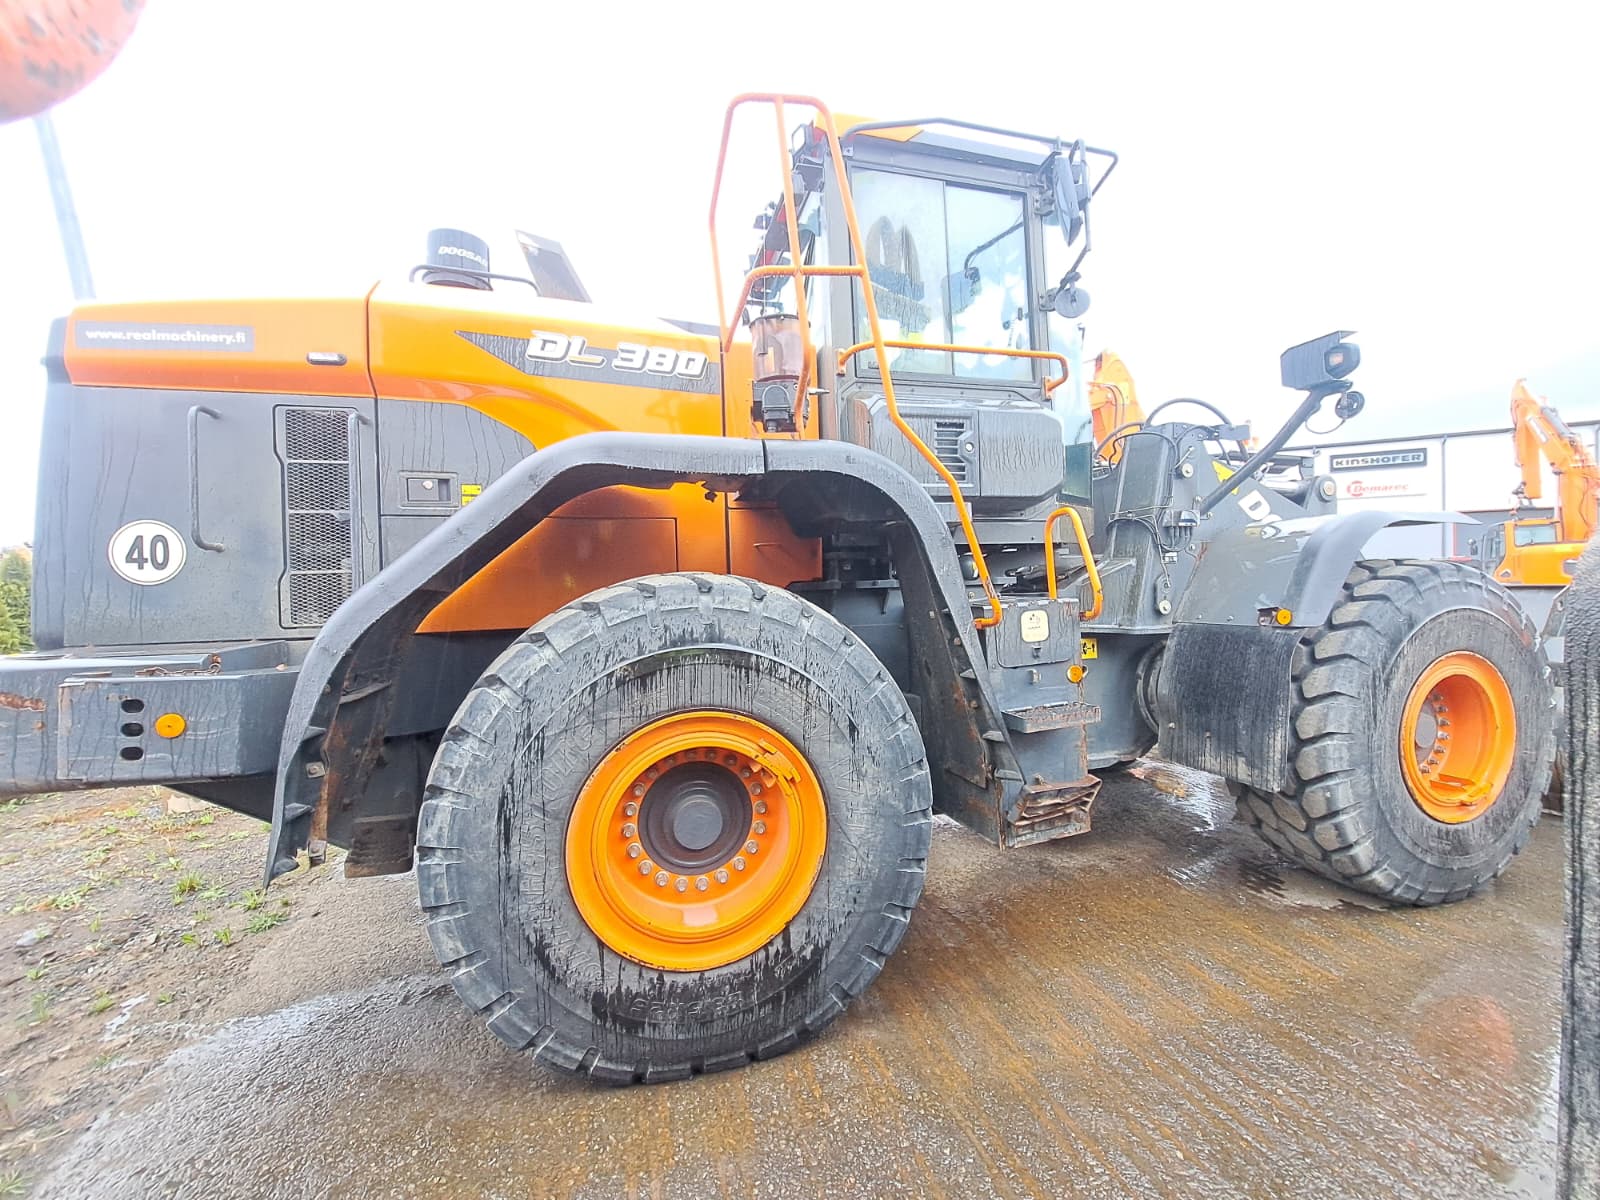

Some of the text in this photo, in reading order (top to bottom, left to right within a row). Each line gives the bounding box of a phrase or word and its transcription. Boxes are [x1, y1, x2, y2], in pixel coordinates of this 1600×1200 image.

[86, 329, 246, 345] www.realmachinery.fi
[525, 329, 708, 380] DL 380
[1334, 453, 1422, 467] KINSHOFER
[125, 534, 170, 571] 40
